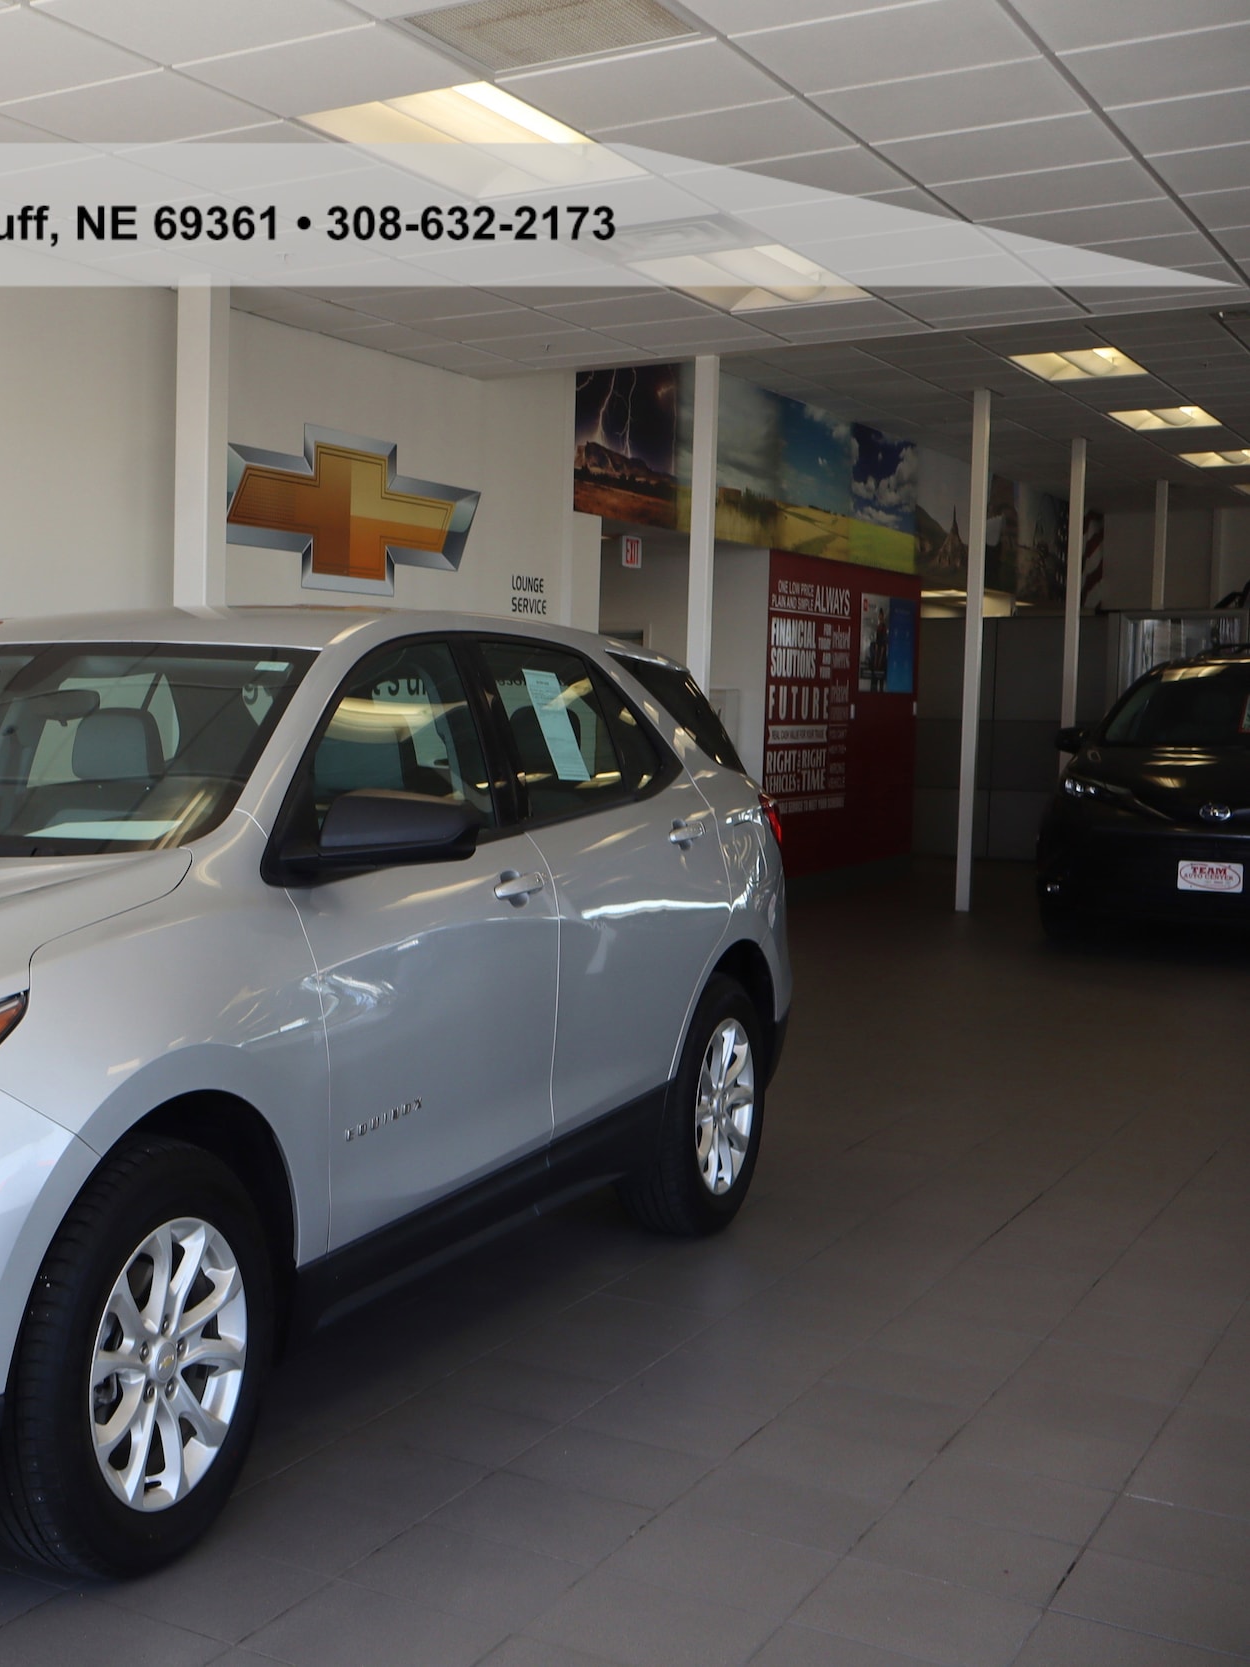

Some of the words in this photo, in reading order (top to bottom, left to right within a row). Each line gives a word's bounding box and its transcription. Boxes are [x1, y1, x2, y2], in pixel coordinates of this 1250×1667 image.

[626, 538, 639, 565] EXIT
[511, 574, 544, 594] LOUNGE
[778, 579, 788, 594] ONE
[511, 596, 547, 615] SERVICE
[814, 585, 851, 616] ALWAYS
[771, 617, 816, 649] FINANCIAL
[770, 647, 816, 679] SOLUTIONS
[768, 685, 829, 721] FUTURE
[766, 750, 797, 774] RIGHT
[801, 748, 827, 768] RIGHT
[765, 773, 796, 793] VEHICLES
[801, 769, 826, 792] TIME
[1191, 866, 1228, 875] TEAM
